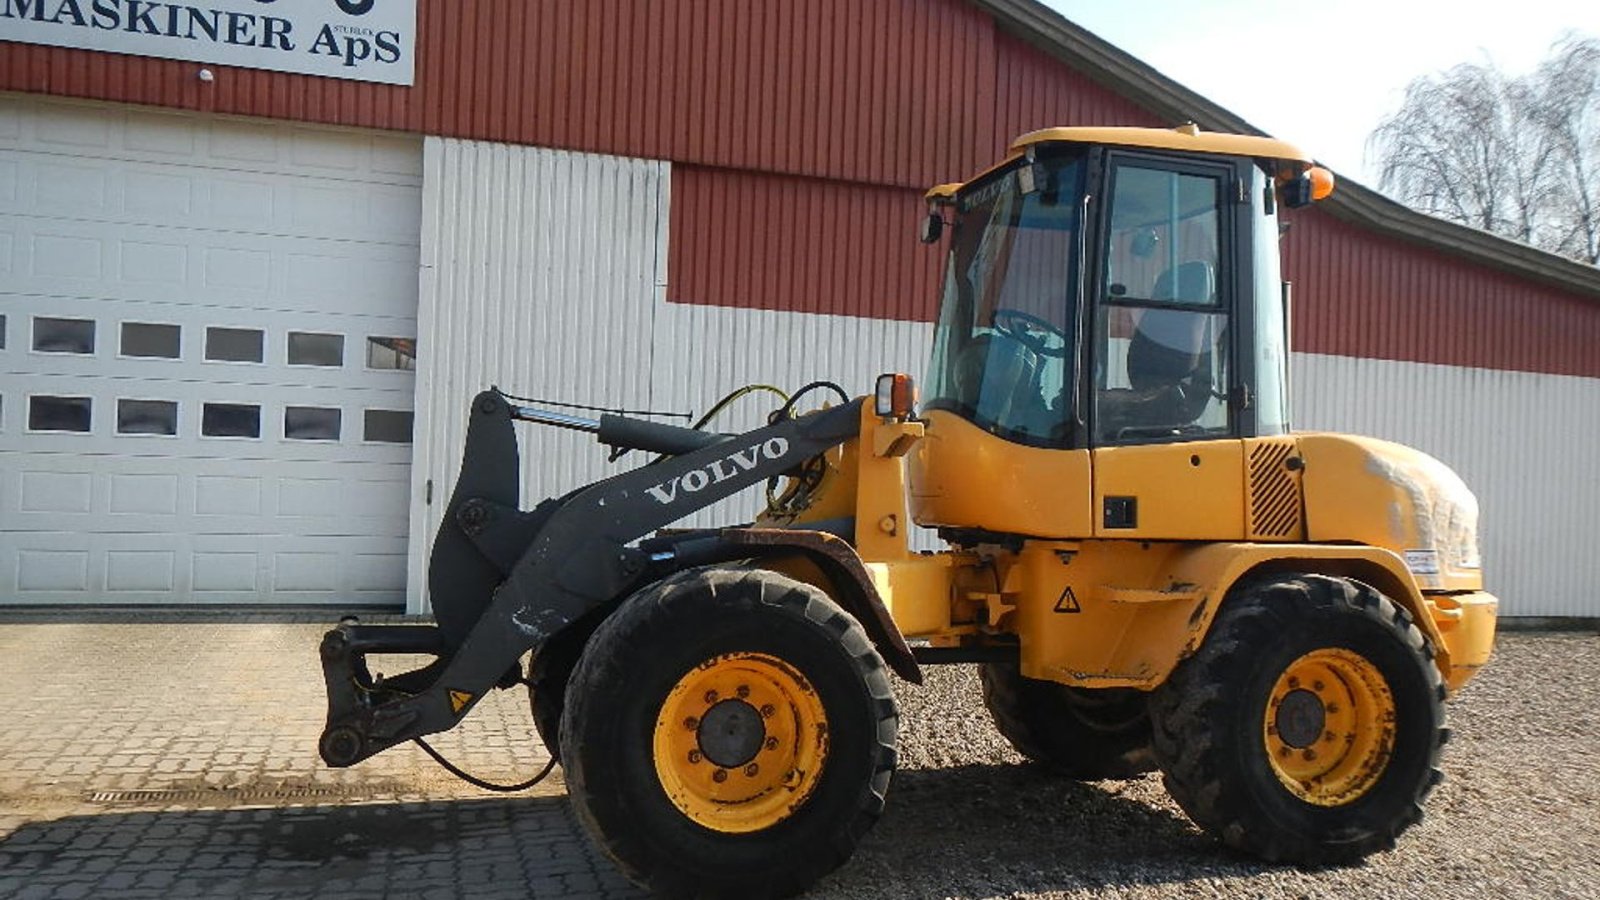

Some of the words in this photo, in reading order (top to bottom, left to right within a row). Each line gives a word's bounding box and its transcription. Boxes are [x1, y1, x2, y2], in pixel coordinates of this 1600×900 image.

[0, 0, 296, 51] MASKINER
[308, 24, 400, 67] ApS
[644, 437, 789, 504] VOLVO
